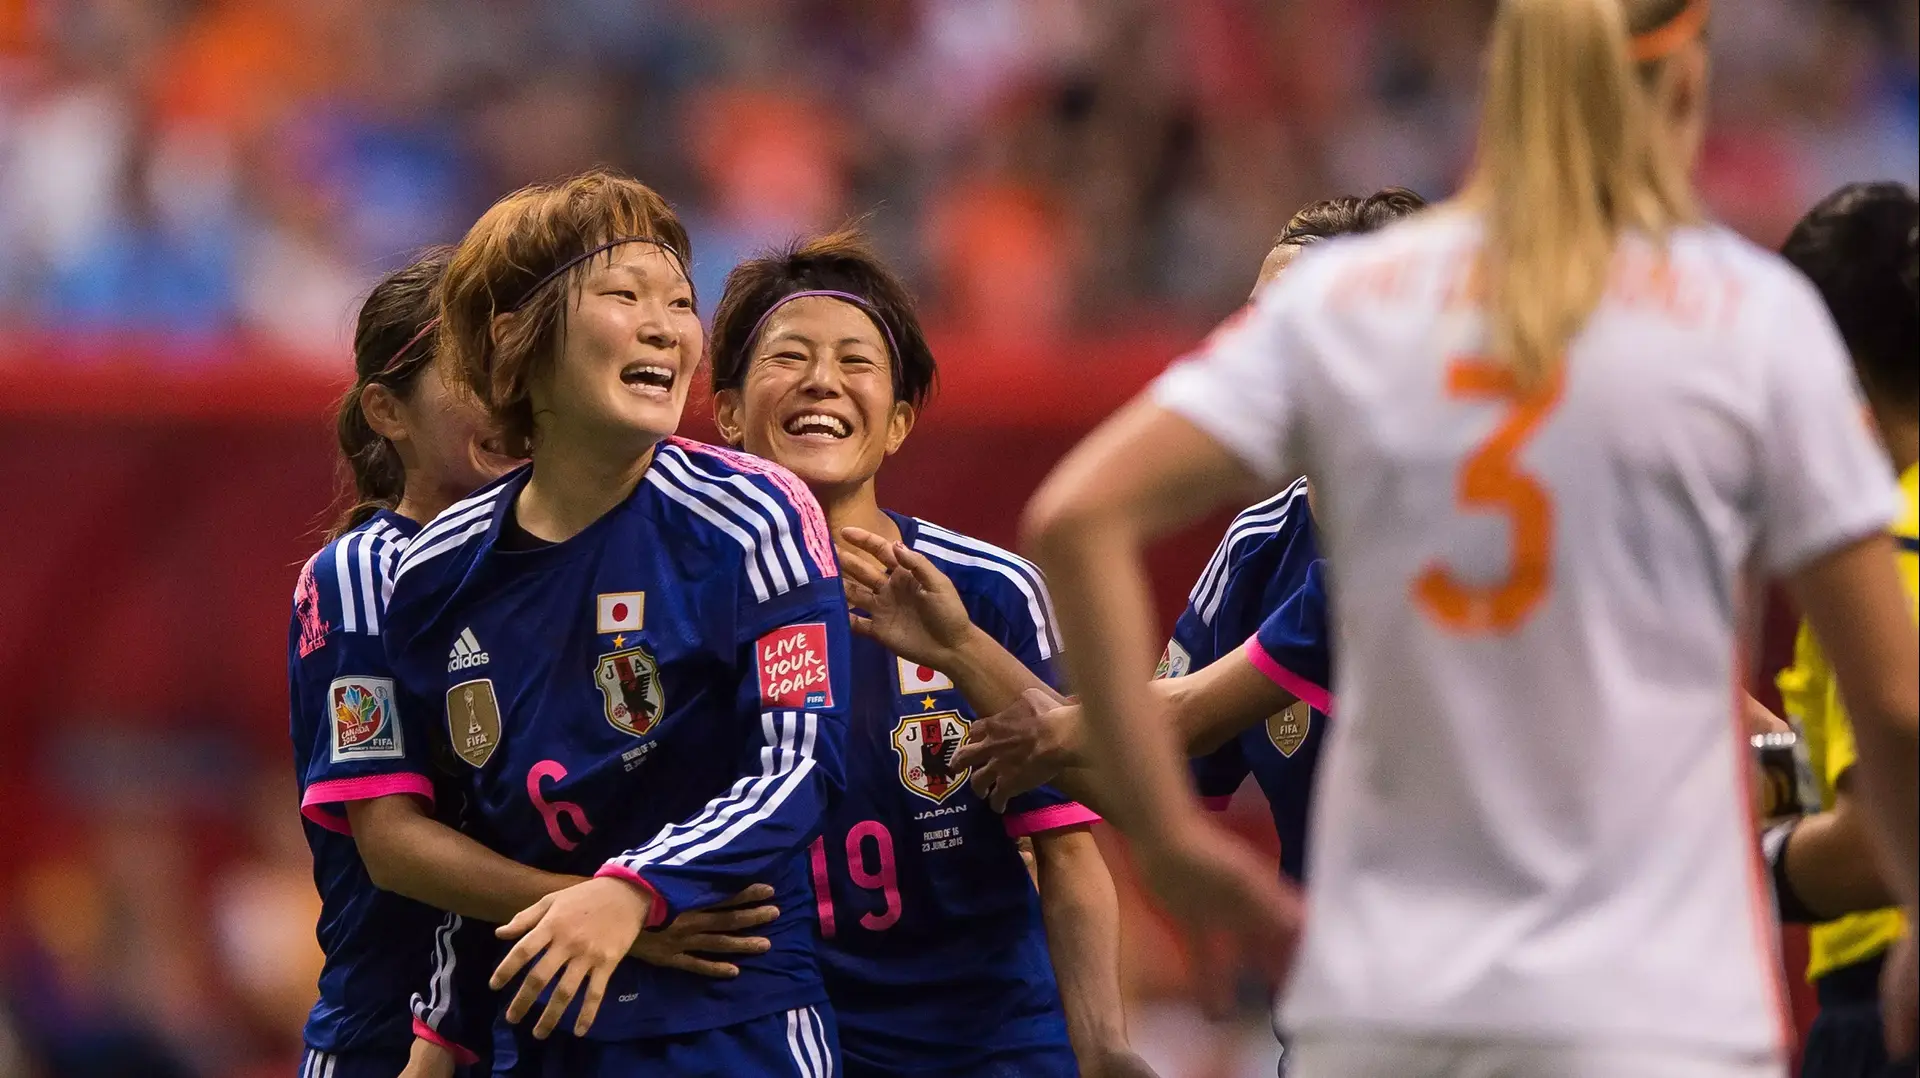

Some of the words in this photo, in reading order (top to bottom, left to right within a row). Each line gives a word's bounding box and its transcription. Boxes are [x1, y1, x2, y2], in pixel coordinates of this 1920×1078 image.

[1412, 356, 1567, 638] 3
[764, 632, 808, 661] LIVE
[765, 650, 822, 681] YOUR
[767, 665, 827, 702] GOALS
[341, 726, 370, 739] CANADA
[906, 722, 959, 741] JFA
[1280, 724, 1298, 735] FIFA
[373, 738, 393, 746] FIFA
[466, 734, 488, 747] FIFA
[526, 760, 593, 851] 6
[914, 804, 967, 820] JAPAN
[923, 830, 944, 842] ROUND
[943, 828, 951, 838] OF
[921, 842, 930, 852] 23
[949, 836, 963, 847] 2015
[807, 820, 902, 939] 19
